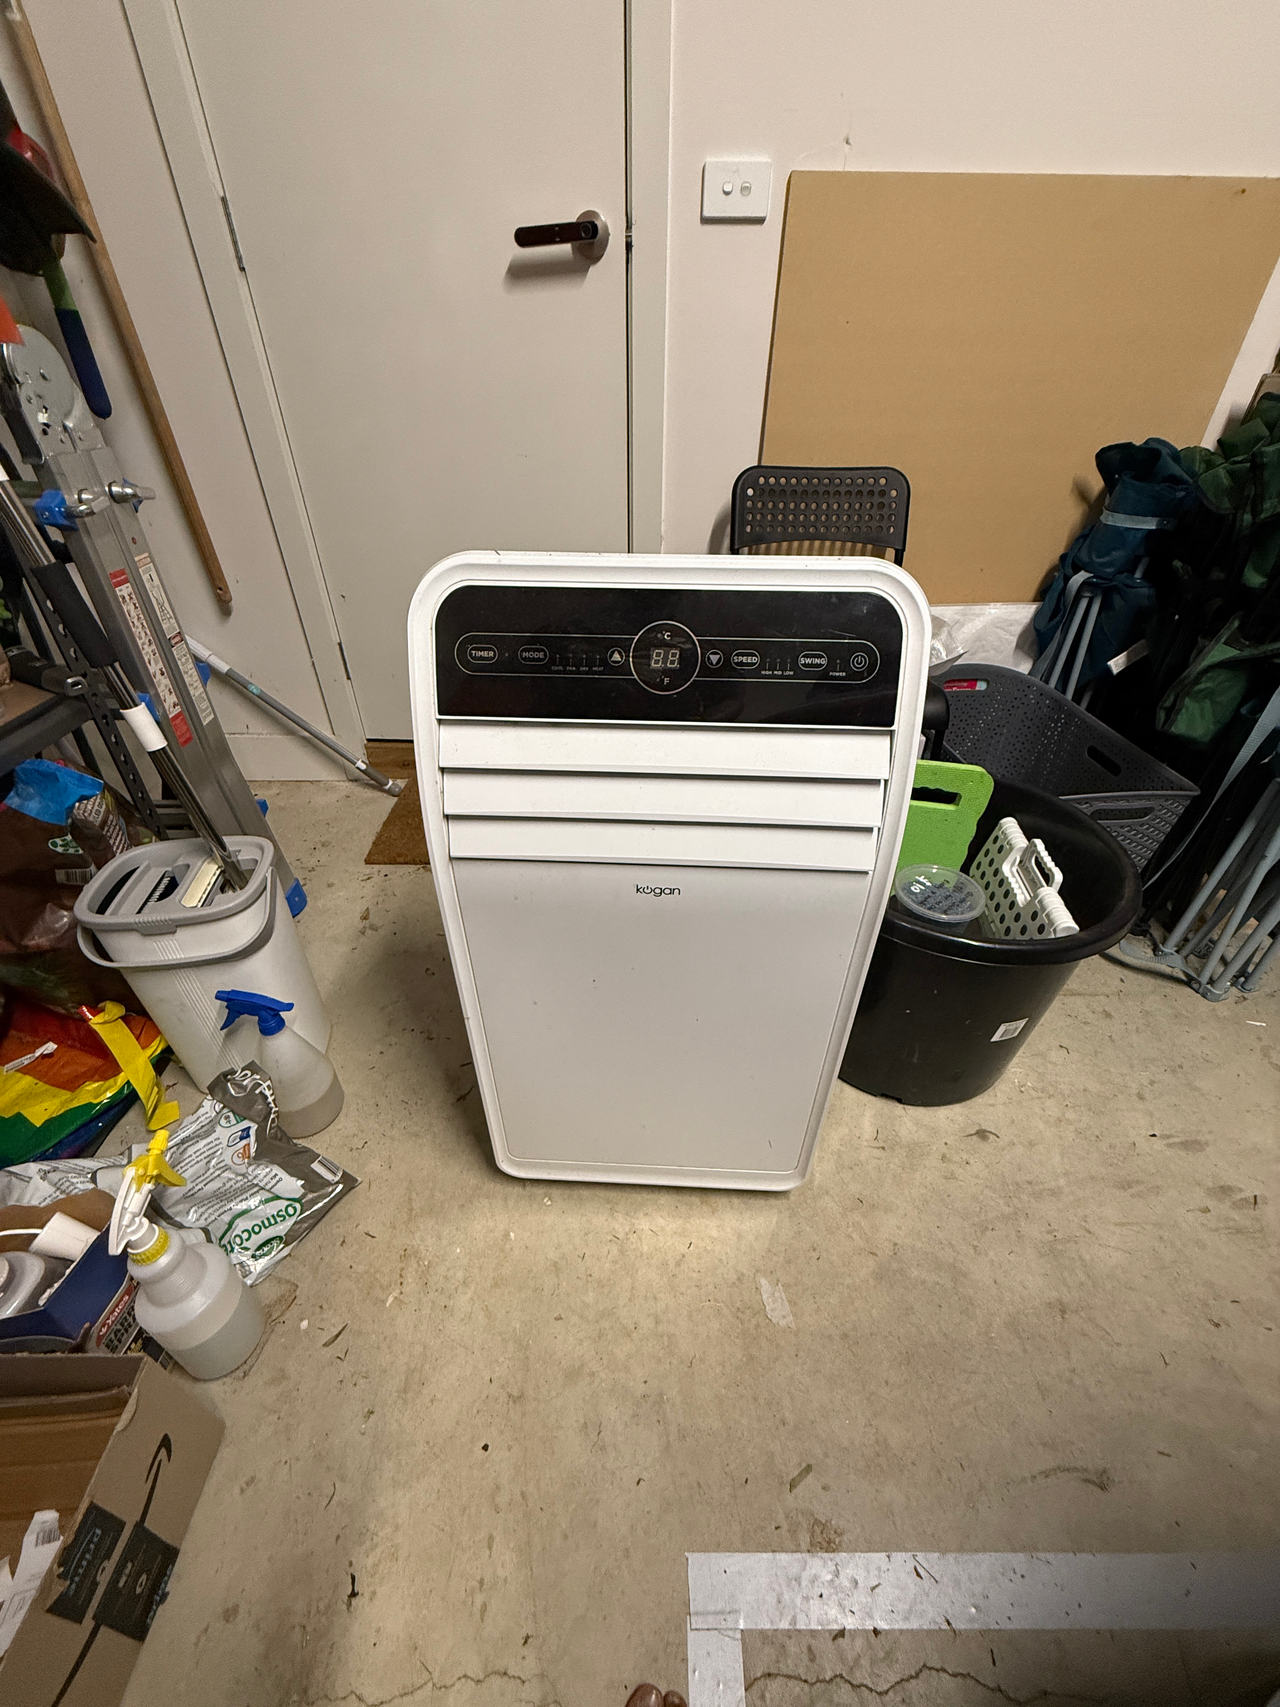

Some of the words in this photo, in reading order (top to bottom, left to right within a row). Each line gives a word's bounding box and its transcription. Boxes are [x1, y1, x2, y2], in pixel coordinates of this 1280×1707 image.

[522, 651, 545, 659] MODE
[800, 657, 826, 665] SWING
[635, 884, 681, 898] kogan
[106, 1294, 129, 1327] Yates
